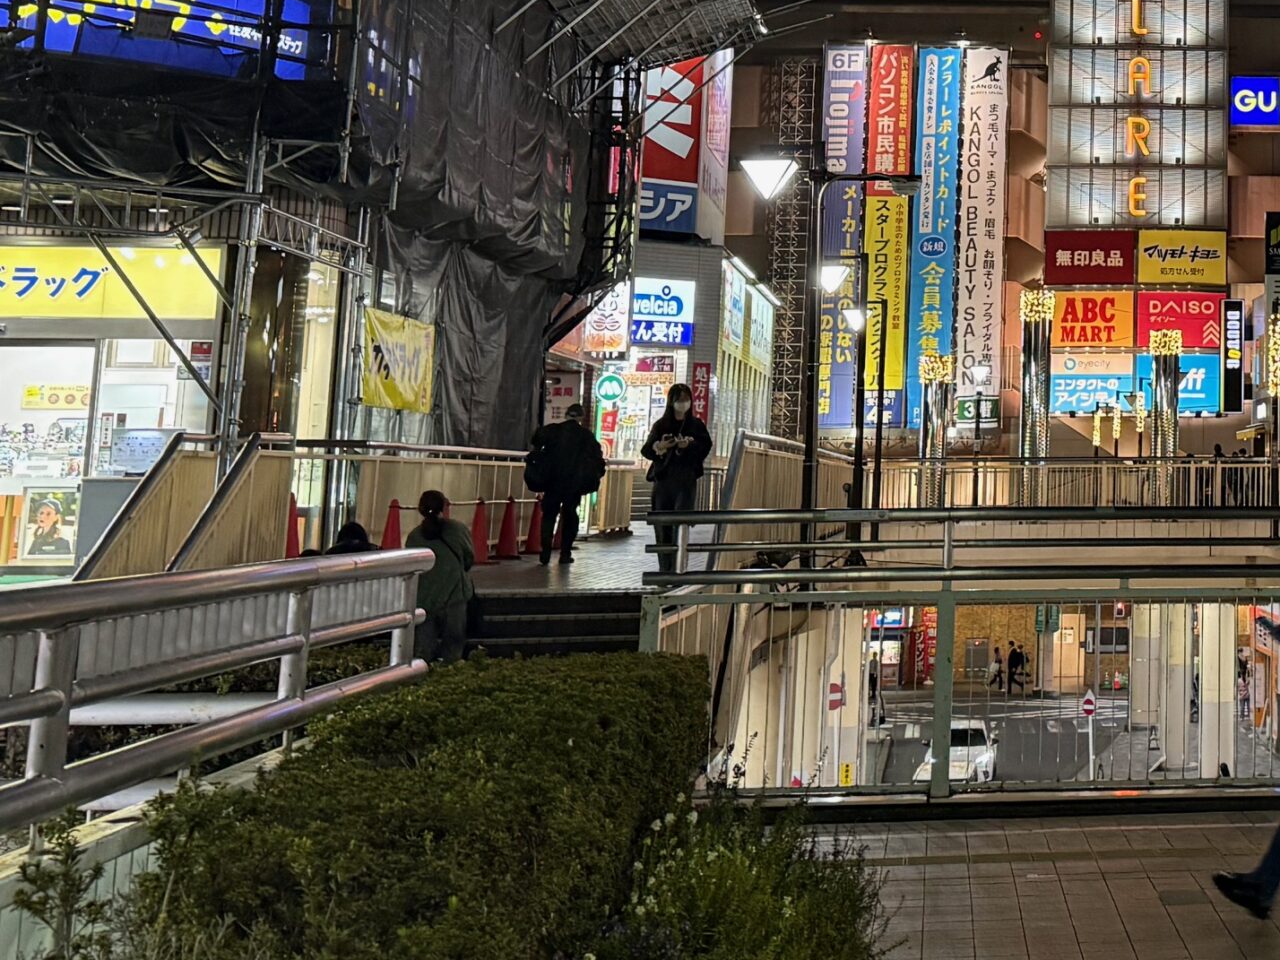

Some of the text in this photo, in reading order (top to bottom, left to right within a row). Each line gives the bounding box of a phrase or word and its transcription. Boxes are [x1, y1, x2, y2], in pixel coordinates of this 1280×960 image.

[832, 53, 860, 69] 6F
[1234, 89, 1277, 113] GU
[936, 55, 954, 233] プラーレポイントカード
[922, 241, 944, 253] 新規
[962, 106, 982, 386] KANGOL BEAUTY SALON
[1143, 243, 1221, 262] マツモトキヨシ
[1055, 248, 1124, 267] 無印良品
[0, 266, 109, 298] ラッグ
[1160, 267, 1205, 276] 処方せん受付
[916, 262, 945, 358] 会員募集
[1061, 297, 1116, 323] ABC
[1149, 300, 1215, 314] DAISO
[1060, 326, 1116, 343] MART
[1226, 310, 1241, 369] DOUTOR
[694, 367, 708, 420] 処方せ
[1055, 378, 1120, 390] コンタクトの
